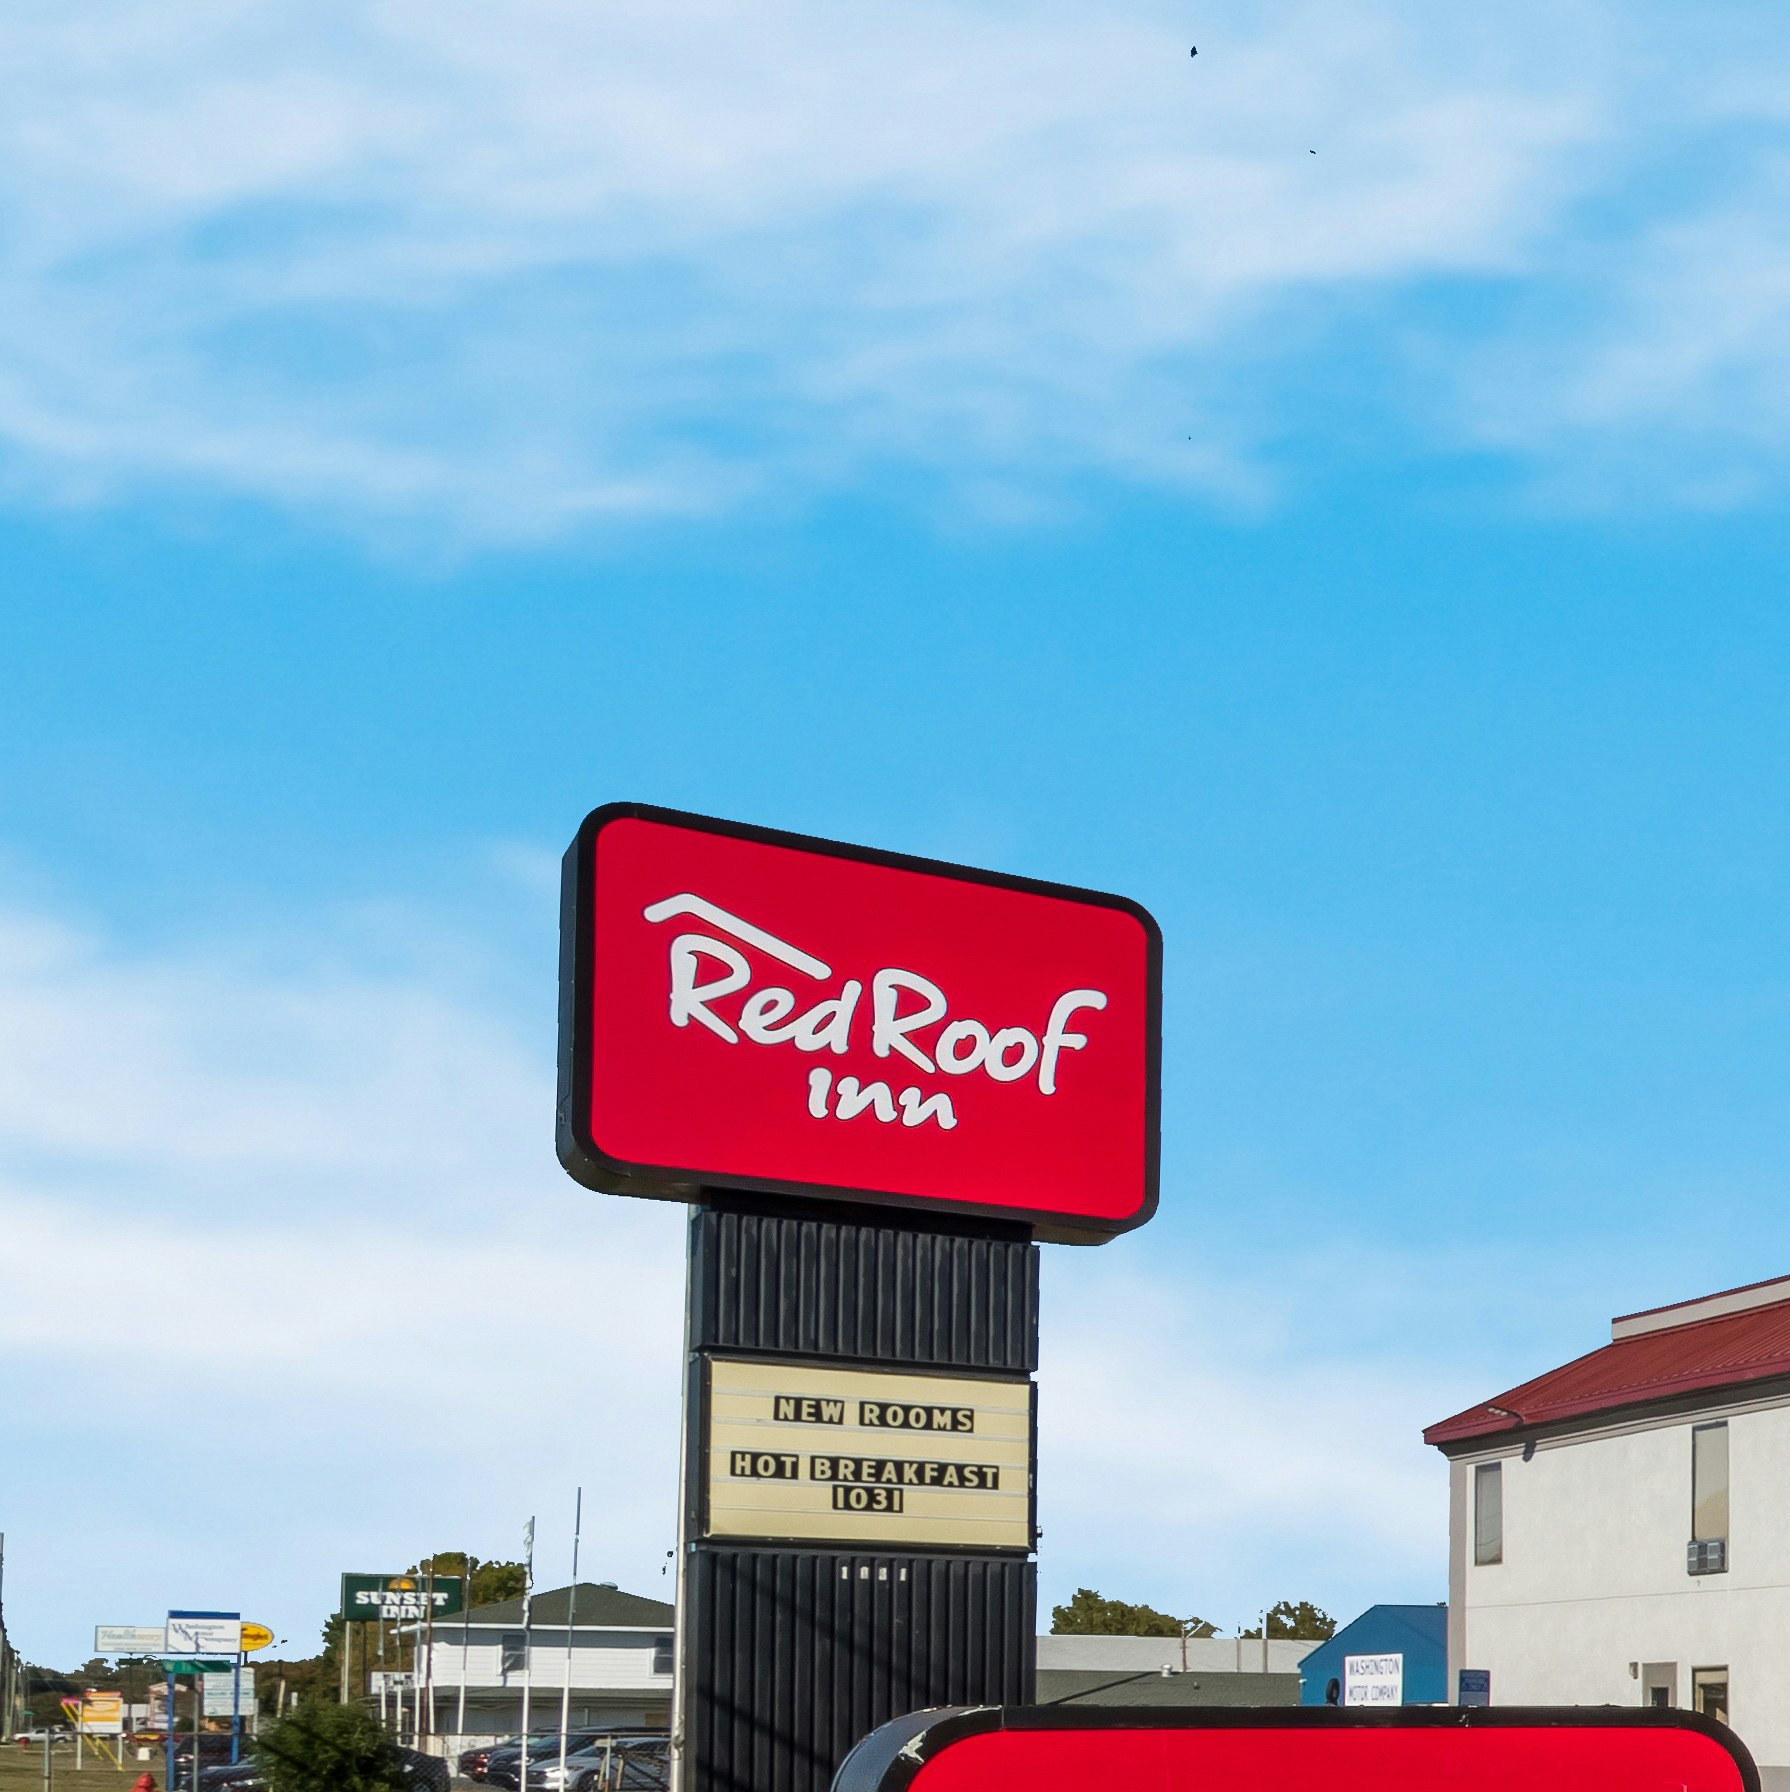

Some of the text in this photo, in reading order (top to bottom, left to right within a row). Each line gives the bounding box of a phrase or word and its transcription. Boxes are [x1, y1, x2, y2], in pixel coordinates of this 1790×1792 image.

[668, 932, 1108, 1096] Red Roof
[778, 1398, 973, 1432] NEW ROOMS
[734, 1453, 999, 1488] HOT BREAKFAST
[835, 1487, 902, 1511] 1031
[355, 1591, 449, 1606] SUNSET
[381, 1605, 426, 1619] INN
[1349, 1658, 1400, 1675] WASHINGTON
[1349, 1685, 1399, 1700] MOTOR COMPANY
